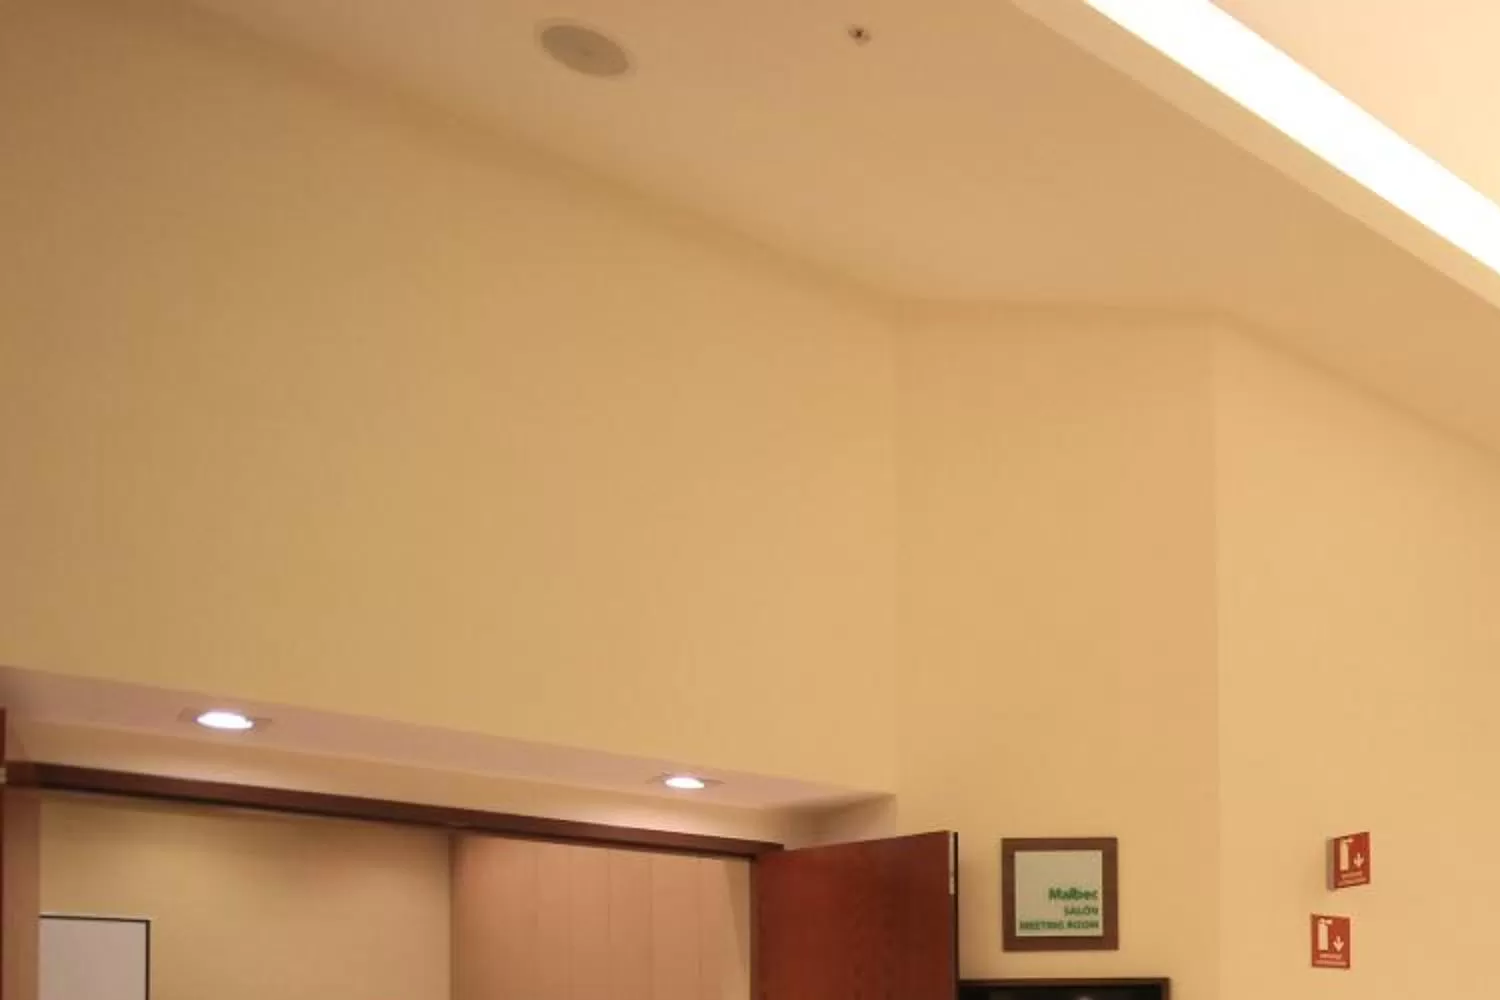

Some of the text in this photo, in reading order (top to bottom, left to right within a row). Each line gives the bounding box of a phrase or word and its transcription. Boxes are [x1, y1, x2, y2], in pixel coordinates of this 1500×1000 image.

[1048, 887, 1099, 901] Malbec
[1019, 920, 1099, 930] MEETING ROOM
